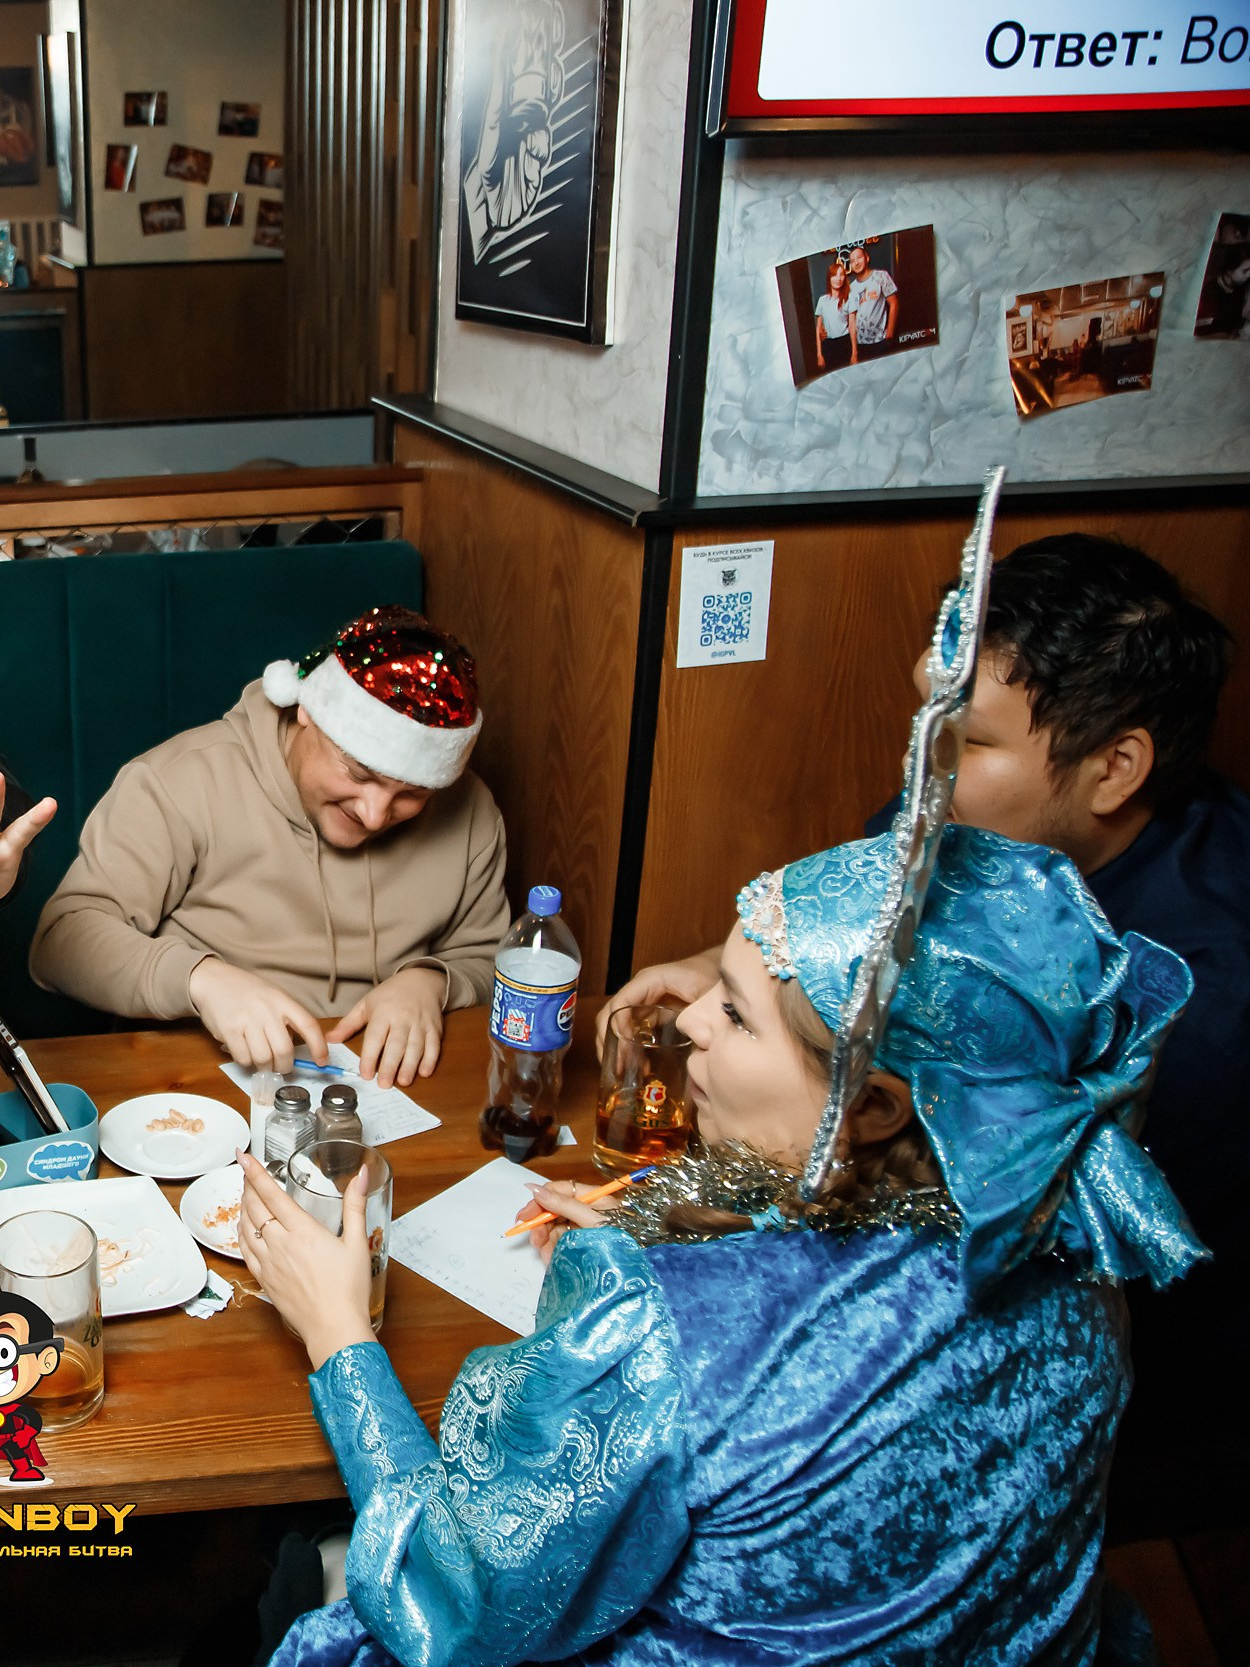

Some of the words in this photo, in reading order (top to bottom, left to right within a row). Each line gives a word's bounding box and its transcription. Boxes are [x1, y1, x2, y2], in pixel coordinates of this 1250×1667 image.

[985, 20, 1163, 69] Ответ:
[1180, 15, 1250, 64] Bo
[491, 981, 504, 1035] PEPSI
